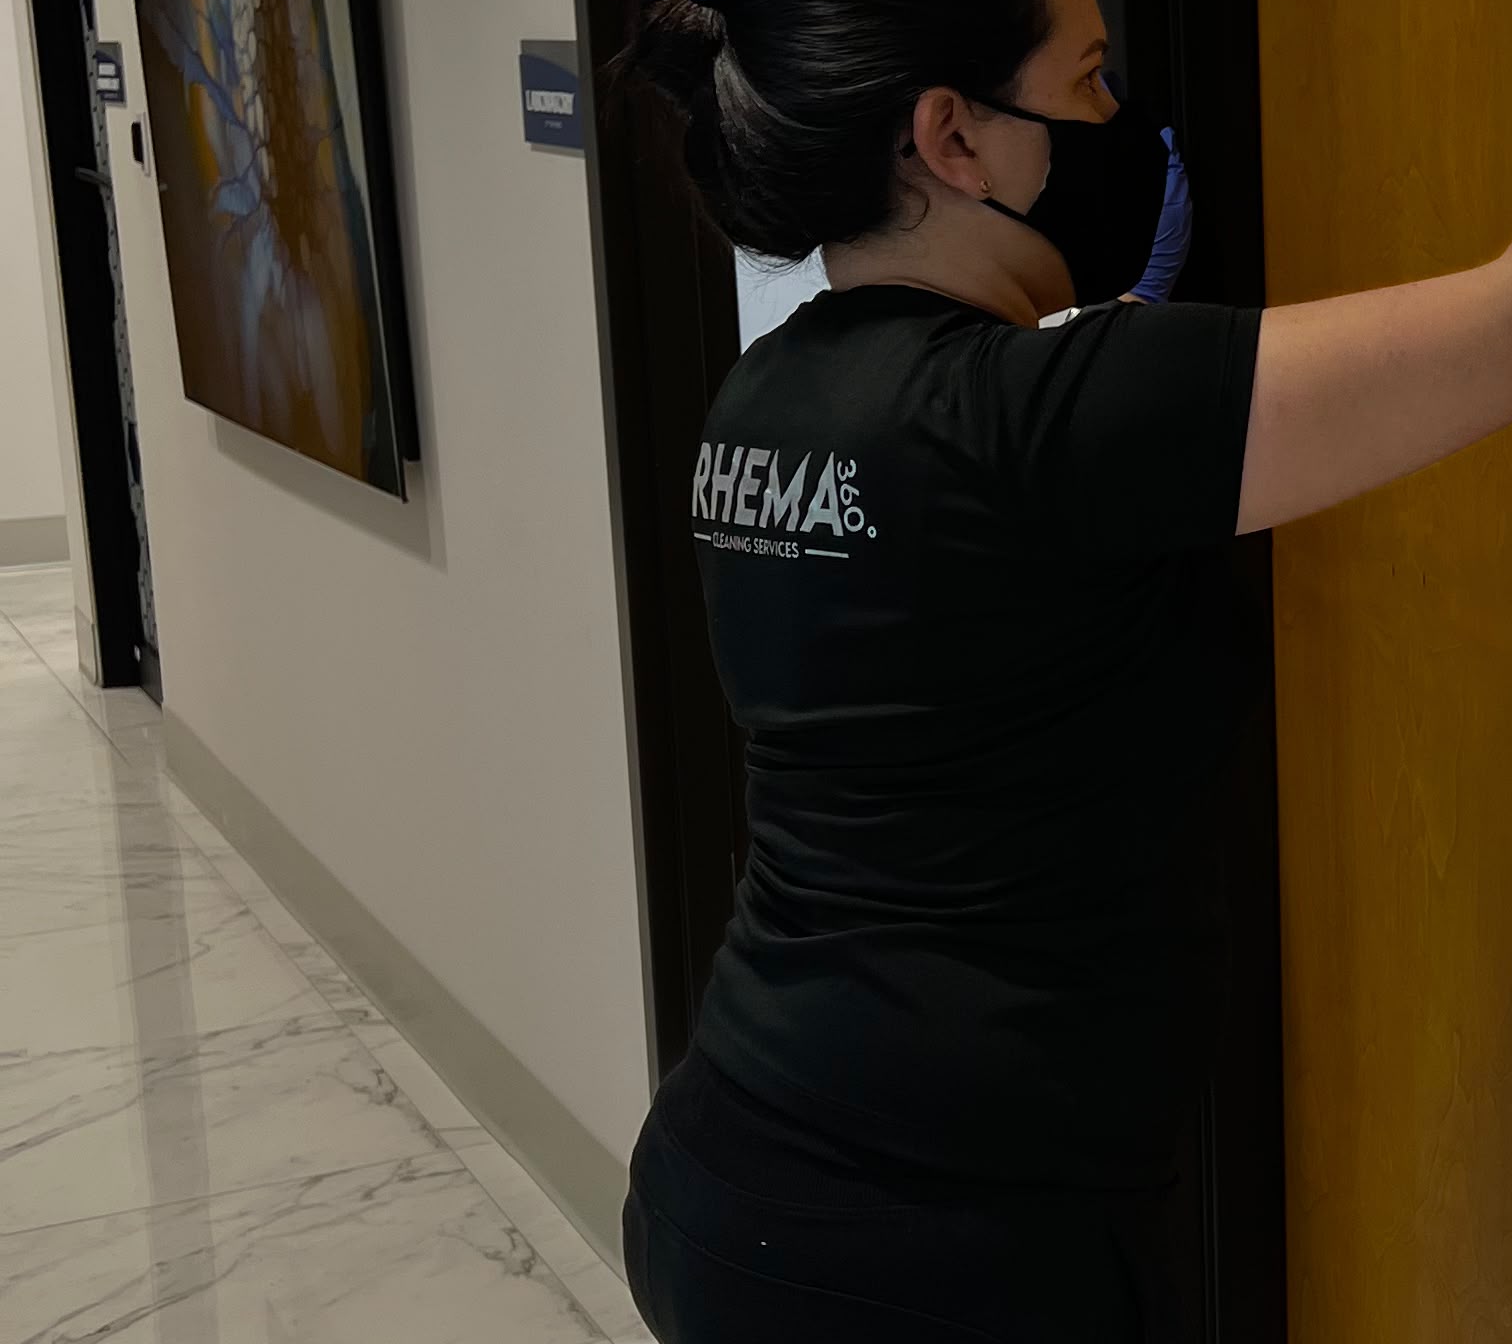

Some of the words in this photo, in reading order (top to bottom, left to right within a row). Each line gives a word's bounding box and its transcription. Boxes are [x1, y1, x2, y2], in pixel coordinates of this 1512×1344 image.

[692, 441, 845, 537] RHEMA
[712, 531, 752, 553] CLEANING
[753, 537, 800, 559] SERVICES
